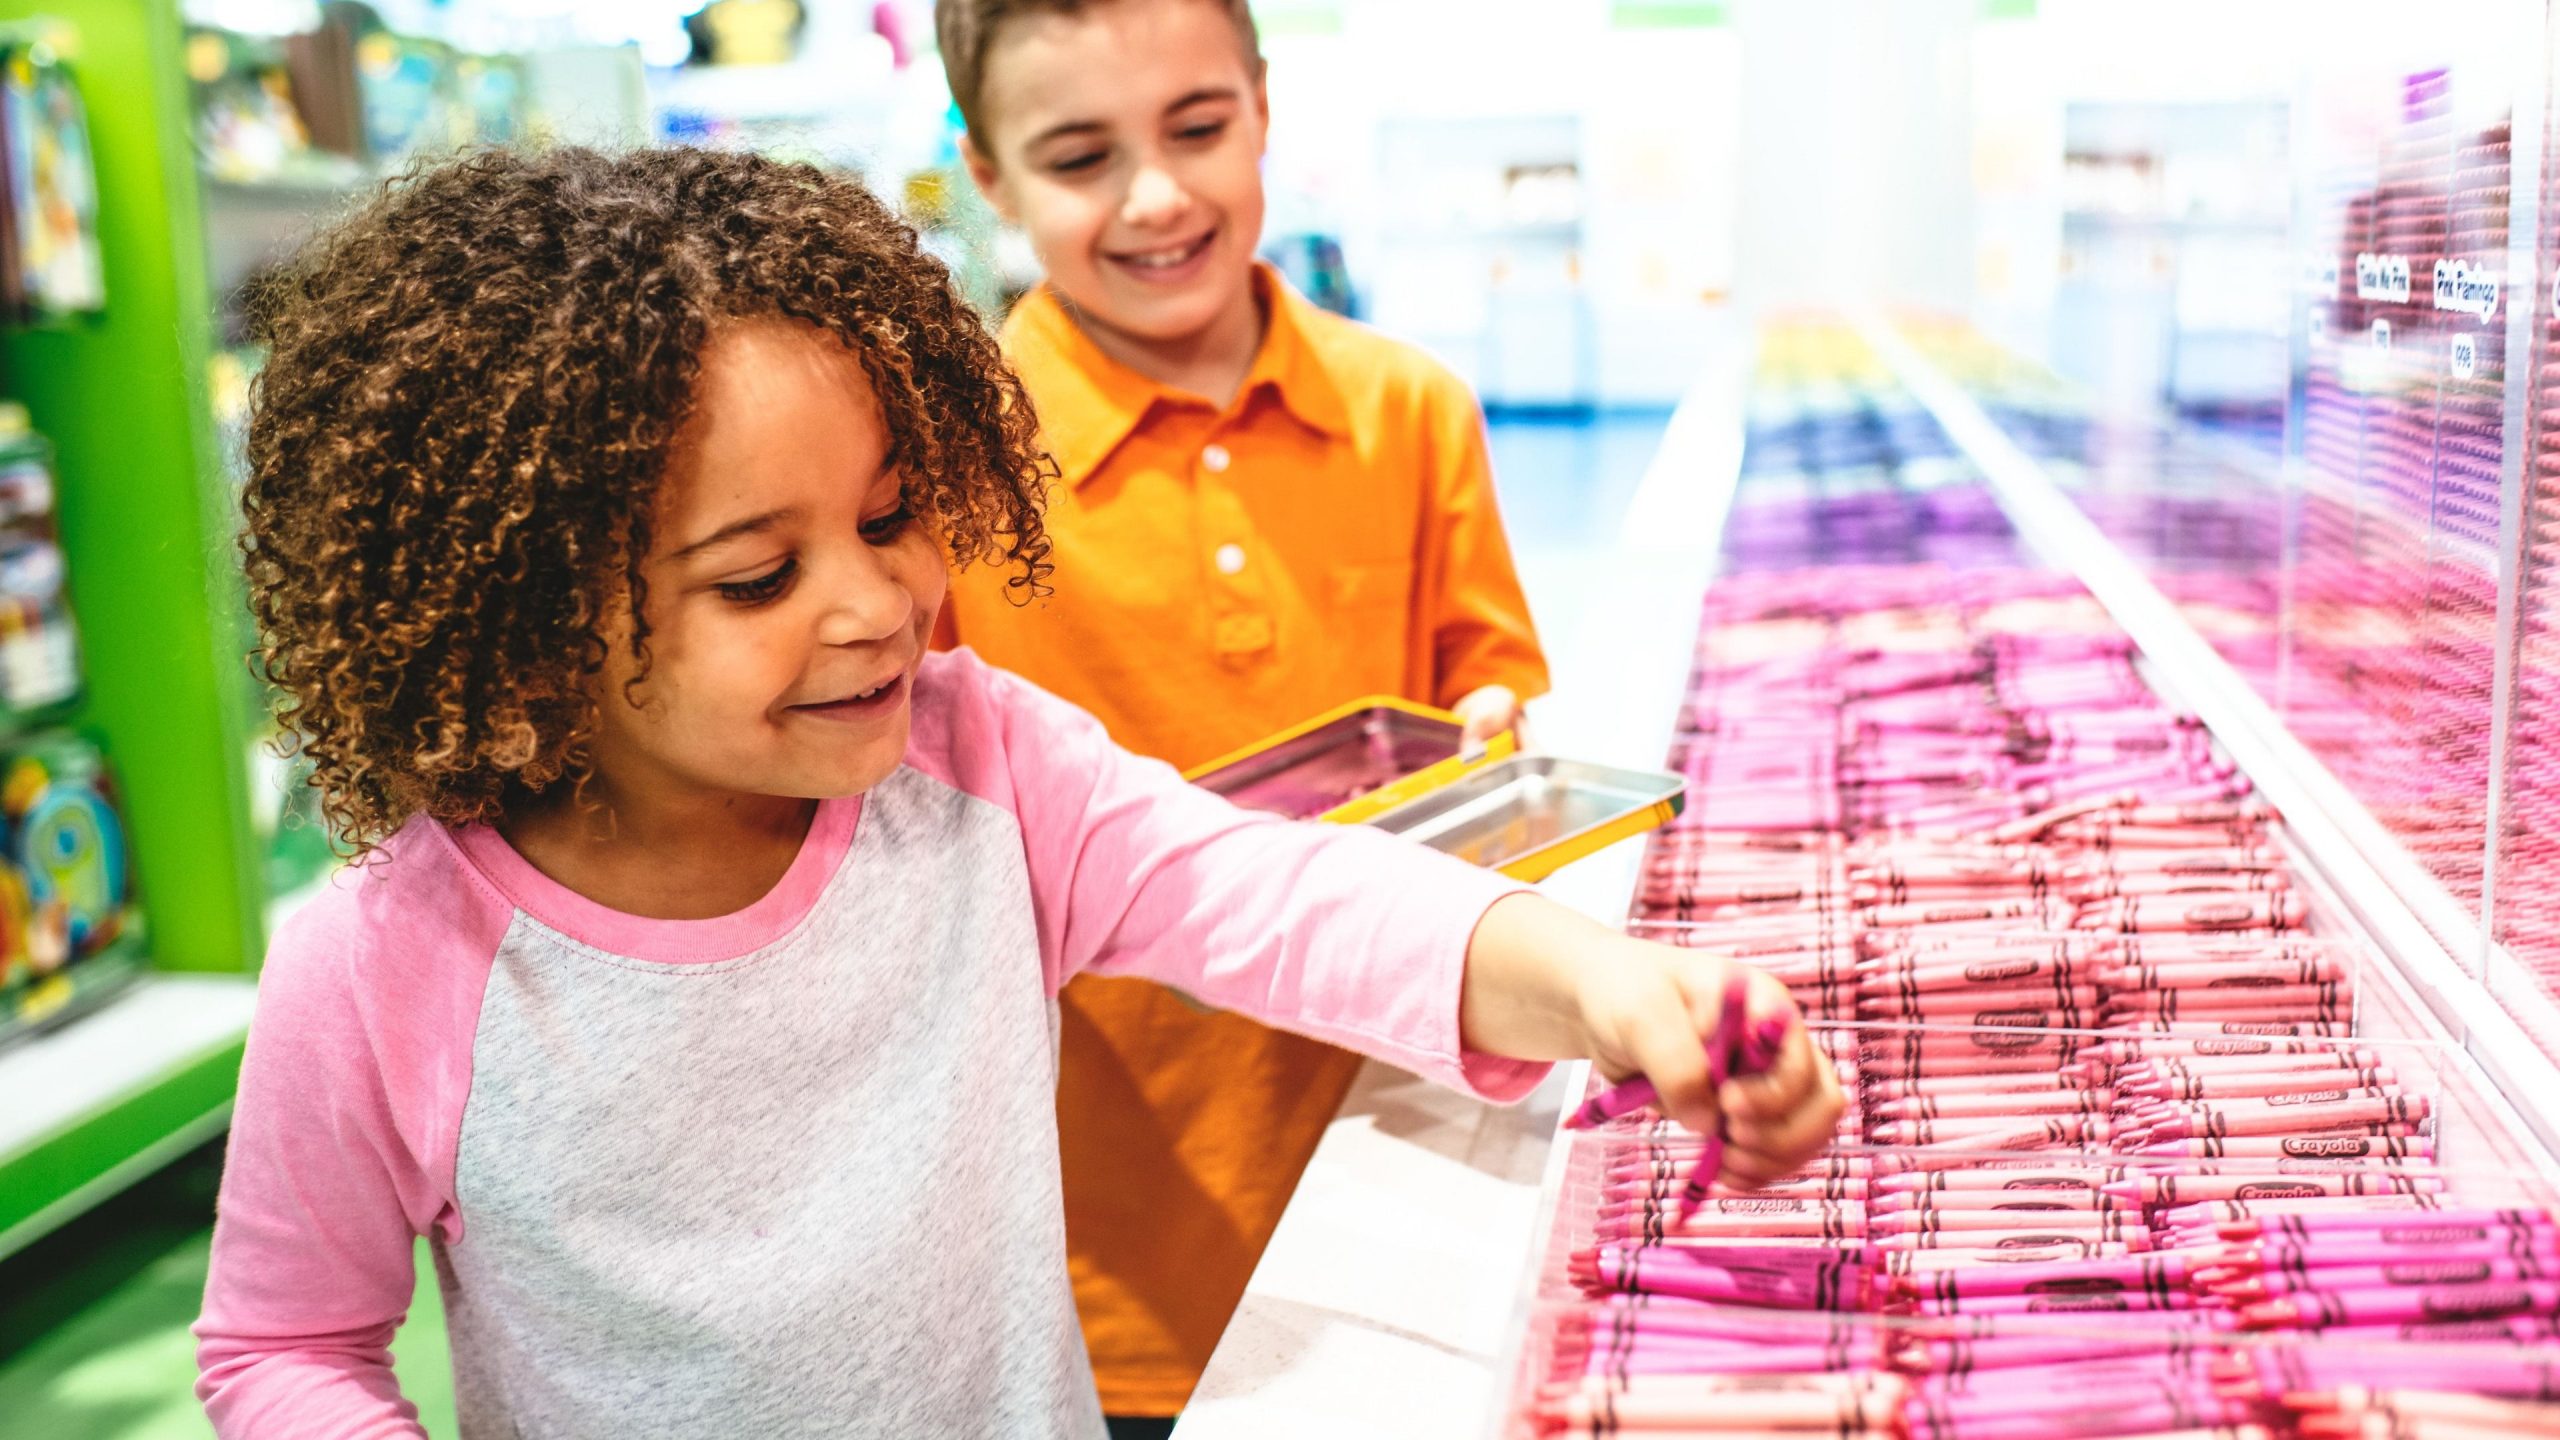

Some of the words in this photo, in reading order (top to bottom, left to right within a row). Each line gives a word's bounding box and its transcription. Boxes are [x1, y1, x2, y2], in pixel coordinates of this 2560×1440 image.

[2437, 269, 2454, 298] Pink
[2456, 270, 2495, 313] Flamingo
[2285, 1138, 2361, 1157] Crayola
